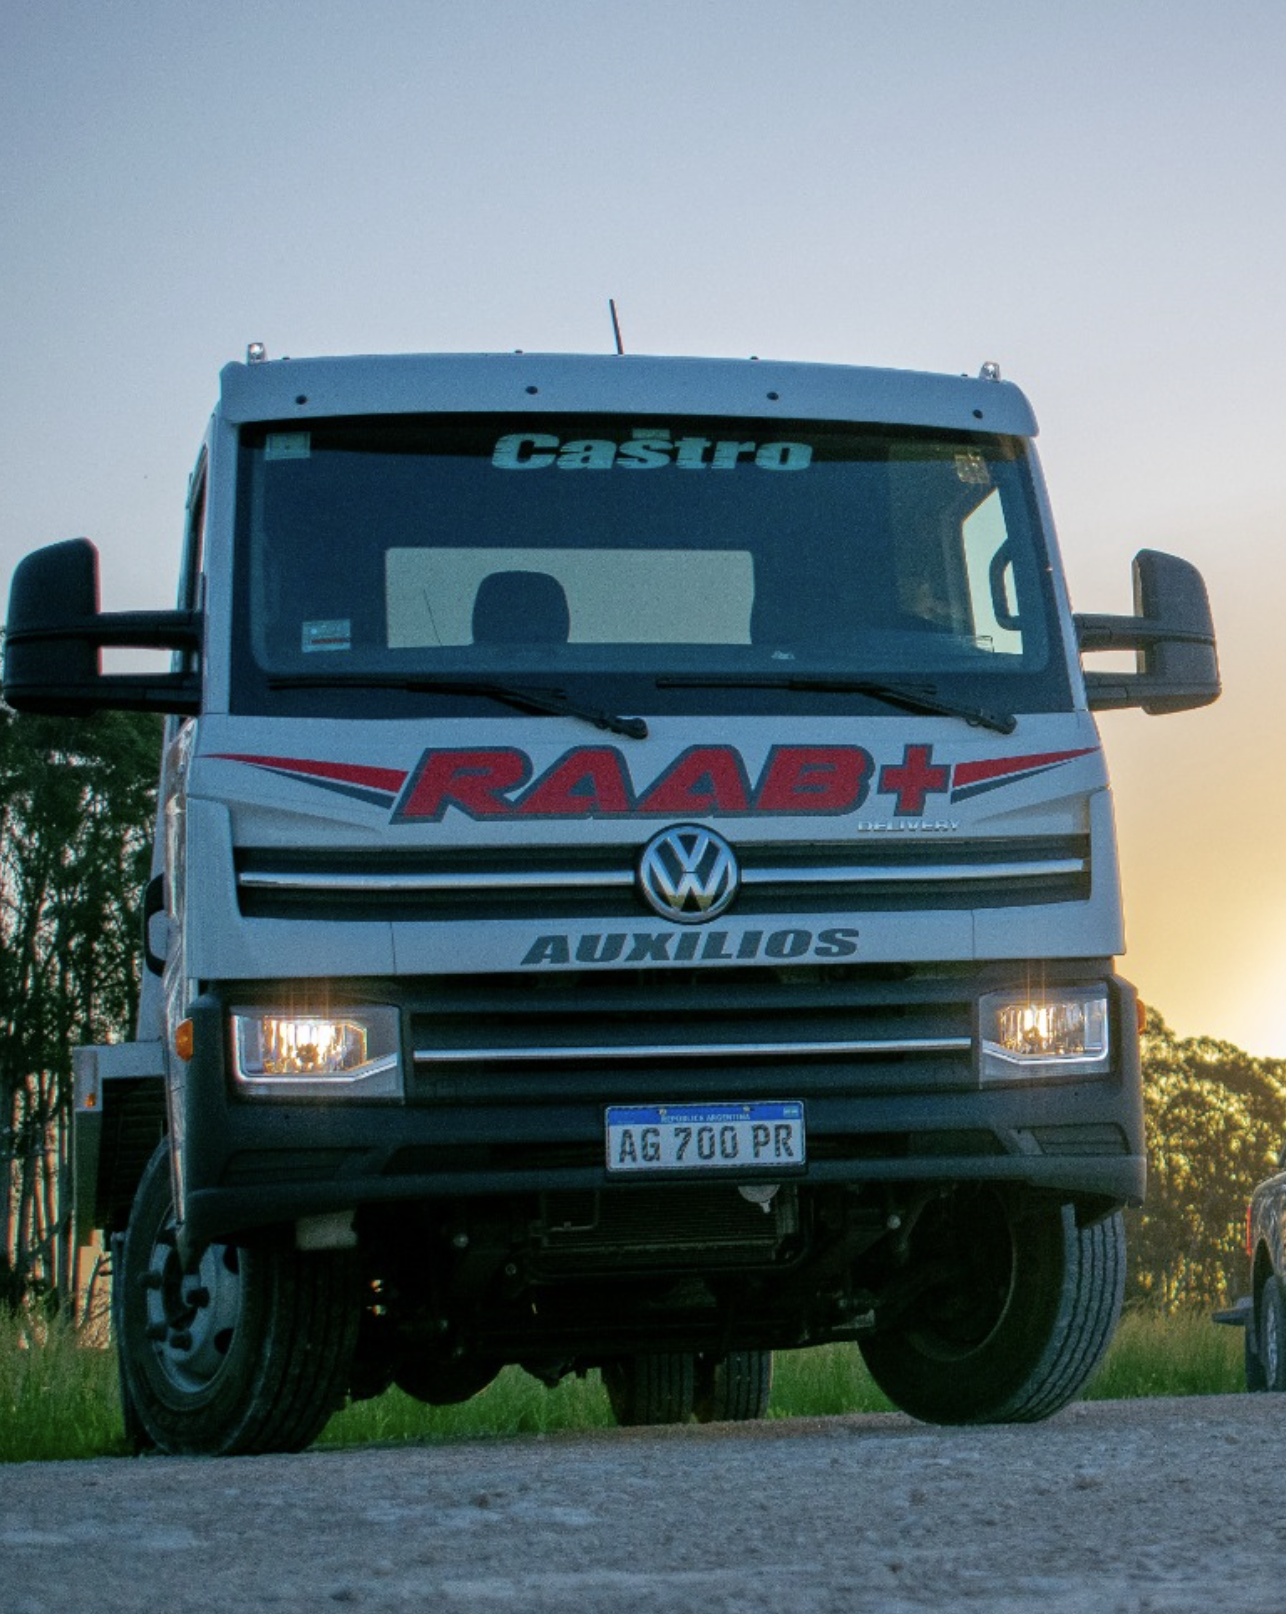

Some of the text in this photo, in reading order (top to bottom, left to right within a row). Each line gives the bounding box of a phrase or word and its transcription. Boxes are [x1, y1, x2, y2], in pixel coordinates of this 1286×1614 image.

[491, 432, 813, 470] Castro
[858, 819, 960, 832] DELIVERY
[520, 928, 860, 966] AUXILIOS
[619, 1123, 794, 1164] AG 700 PR
